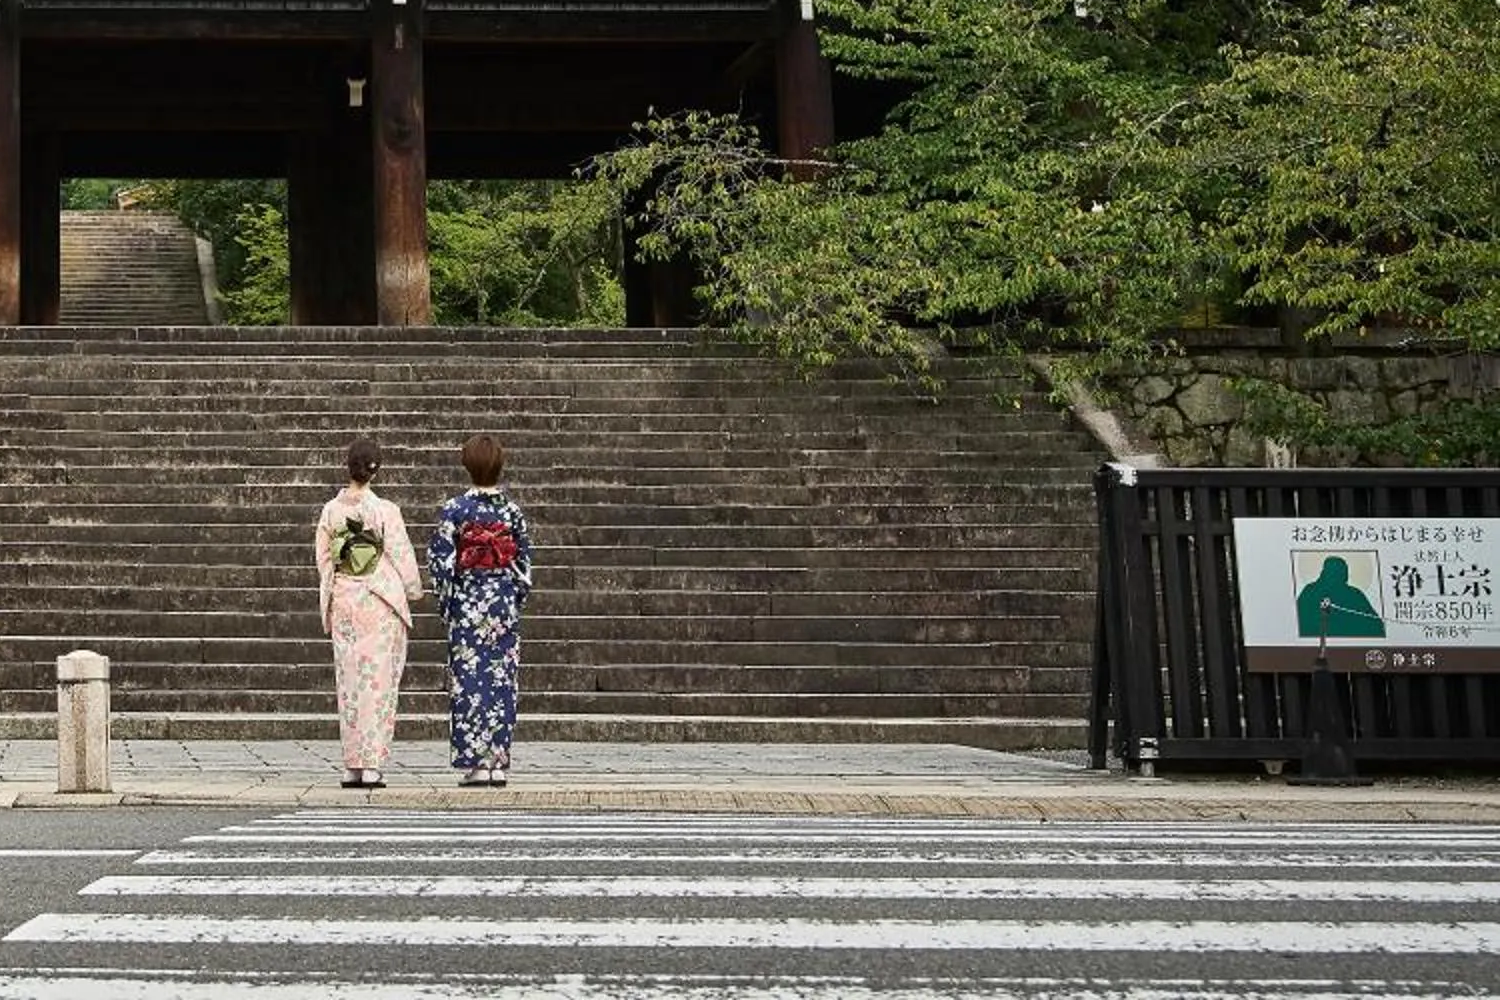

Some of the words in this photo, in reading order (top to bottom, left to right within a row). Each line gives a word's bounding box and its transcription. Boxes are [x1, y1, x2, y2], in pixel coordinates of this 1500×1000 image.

[1391, 564, 1492, 598] 浄土宗
[1393, 600, 1493, 620] 開宗850年
[1392, 653, 1435, 668] 浄土宗
